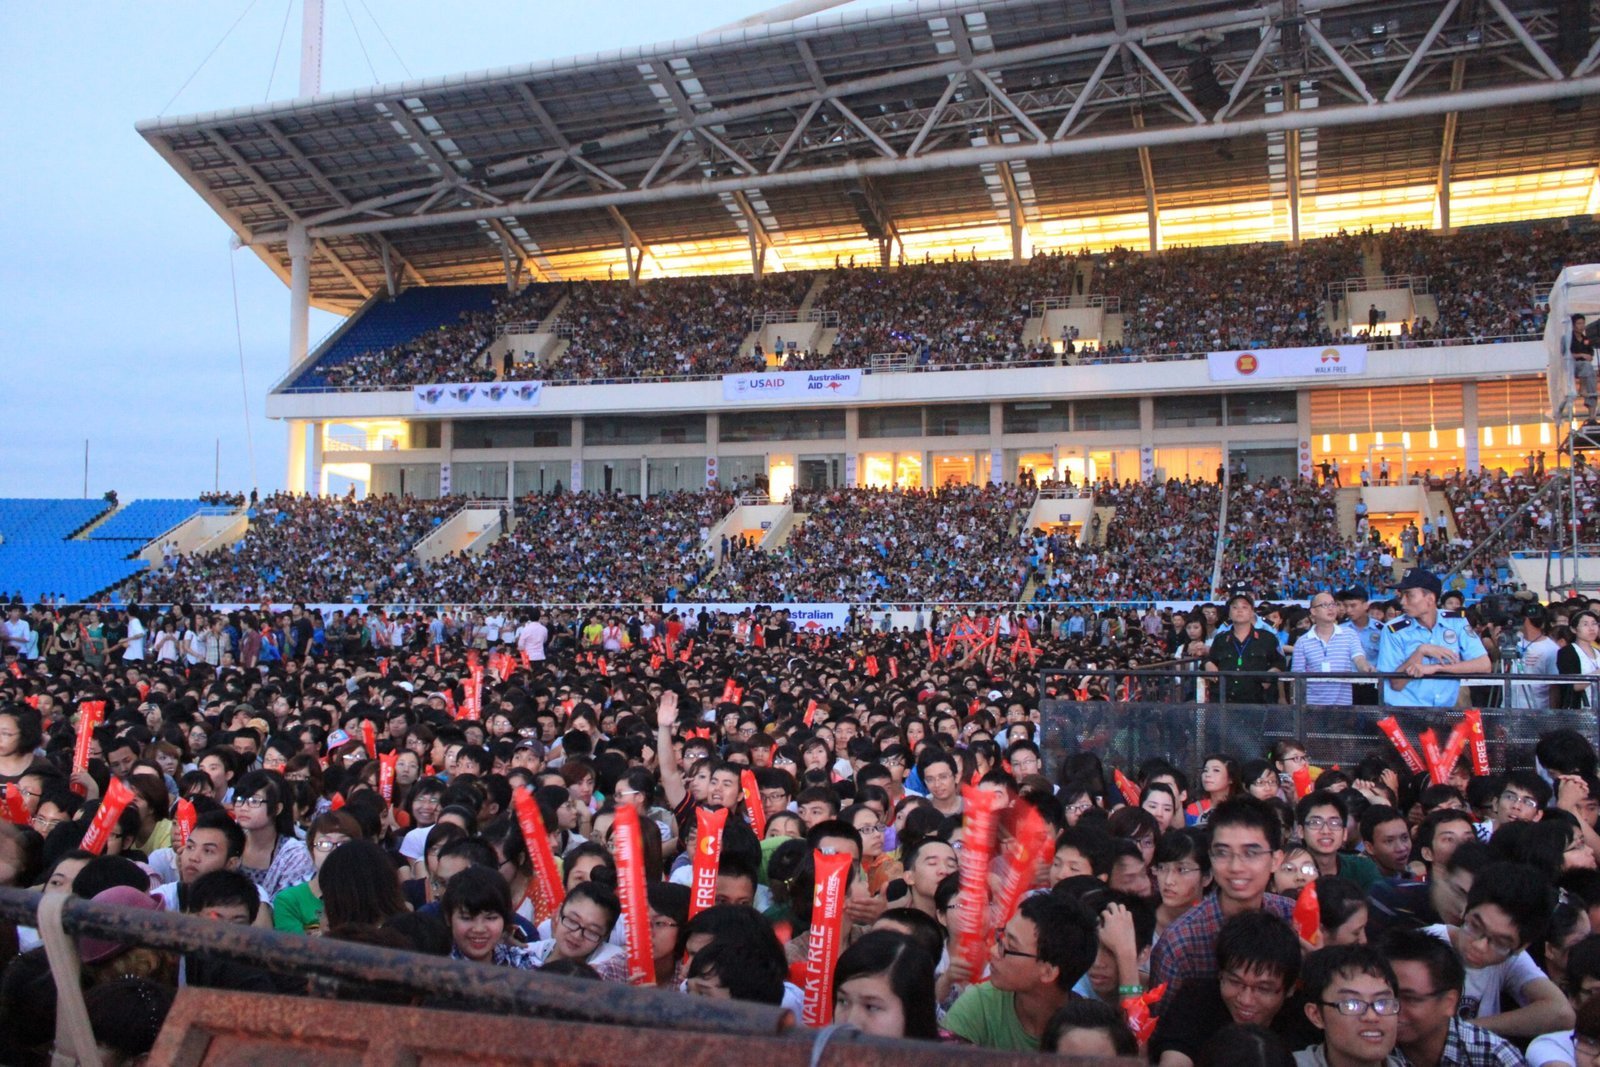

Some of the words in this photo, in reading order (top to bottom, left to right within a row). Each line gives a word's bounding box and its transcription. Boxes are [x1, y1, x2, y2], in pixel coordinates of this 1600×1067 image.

[750, 379, 785, 389] USAID
[808, 373, 850, 381] Australian
[808, 382, 823, 390] AID
[1476, 740, 1488, 763] FREE
[696, 868, 715, 908] FREE
[827, 876, 838, 895] FREE
[824, 897, 836, 919] WALK
[806, 924, 825, 974] FREE
